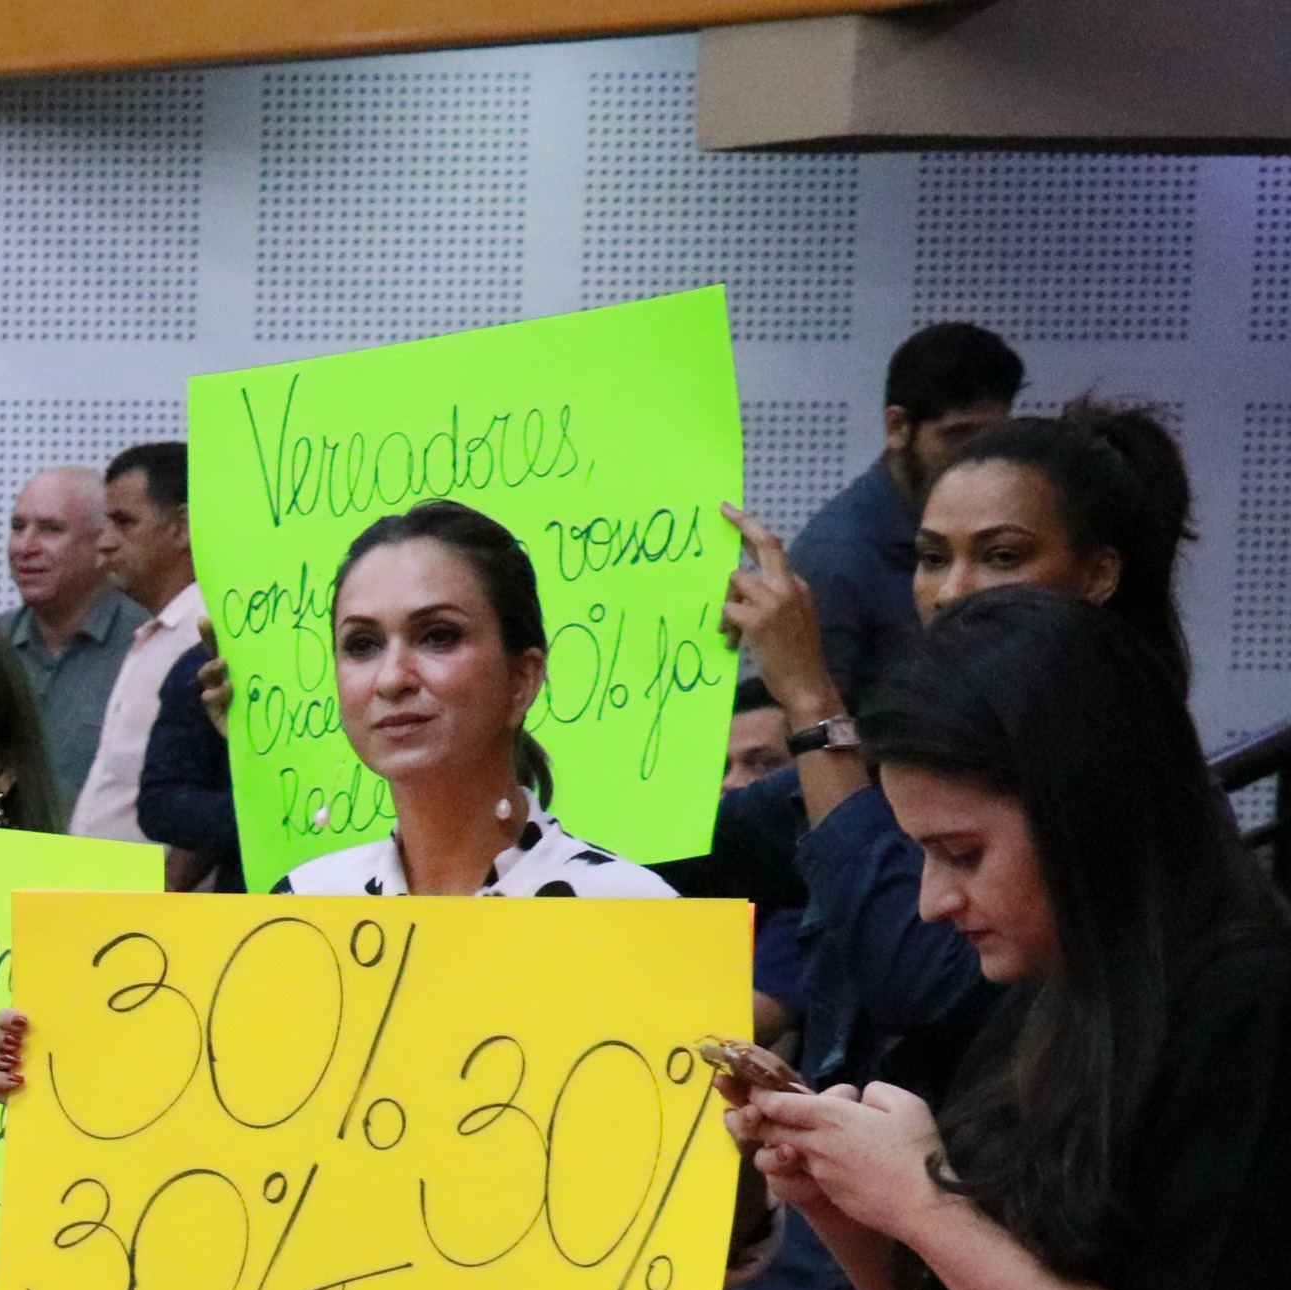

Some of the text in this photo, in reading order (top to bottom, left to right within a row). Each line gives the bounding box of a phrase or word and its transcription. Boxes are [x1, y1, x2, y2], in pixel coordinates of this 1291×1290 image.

[241, 373, 594, 528] Vereadores,
[223, 505, 703, 692] confi vossas
[246, 602, 721, 780] Exce 0% Já
[48, 916, 416, 1150] 30%
